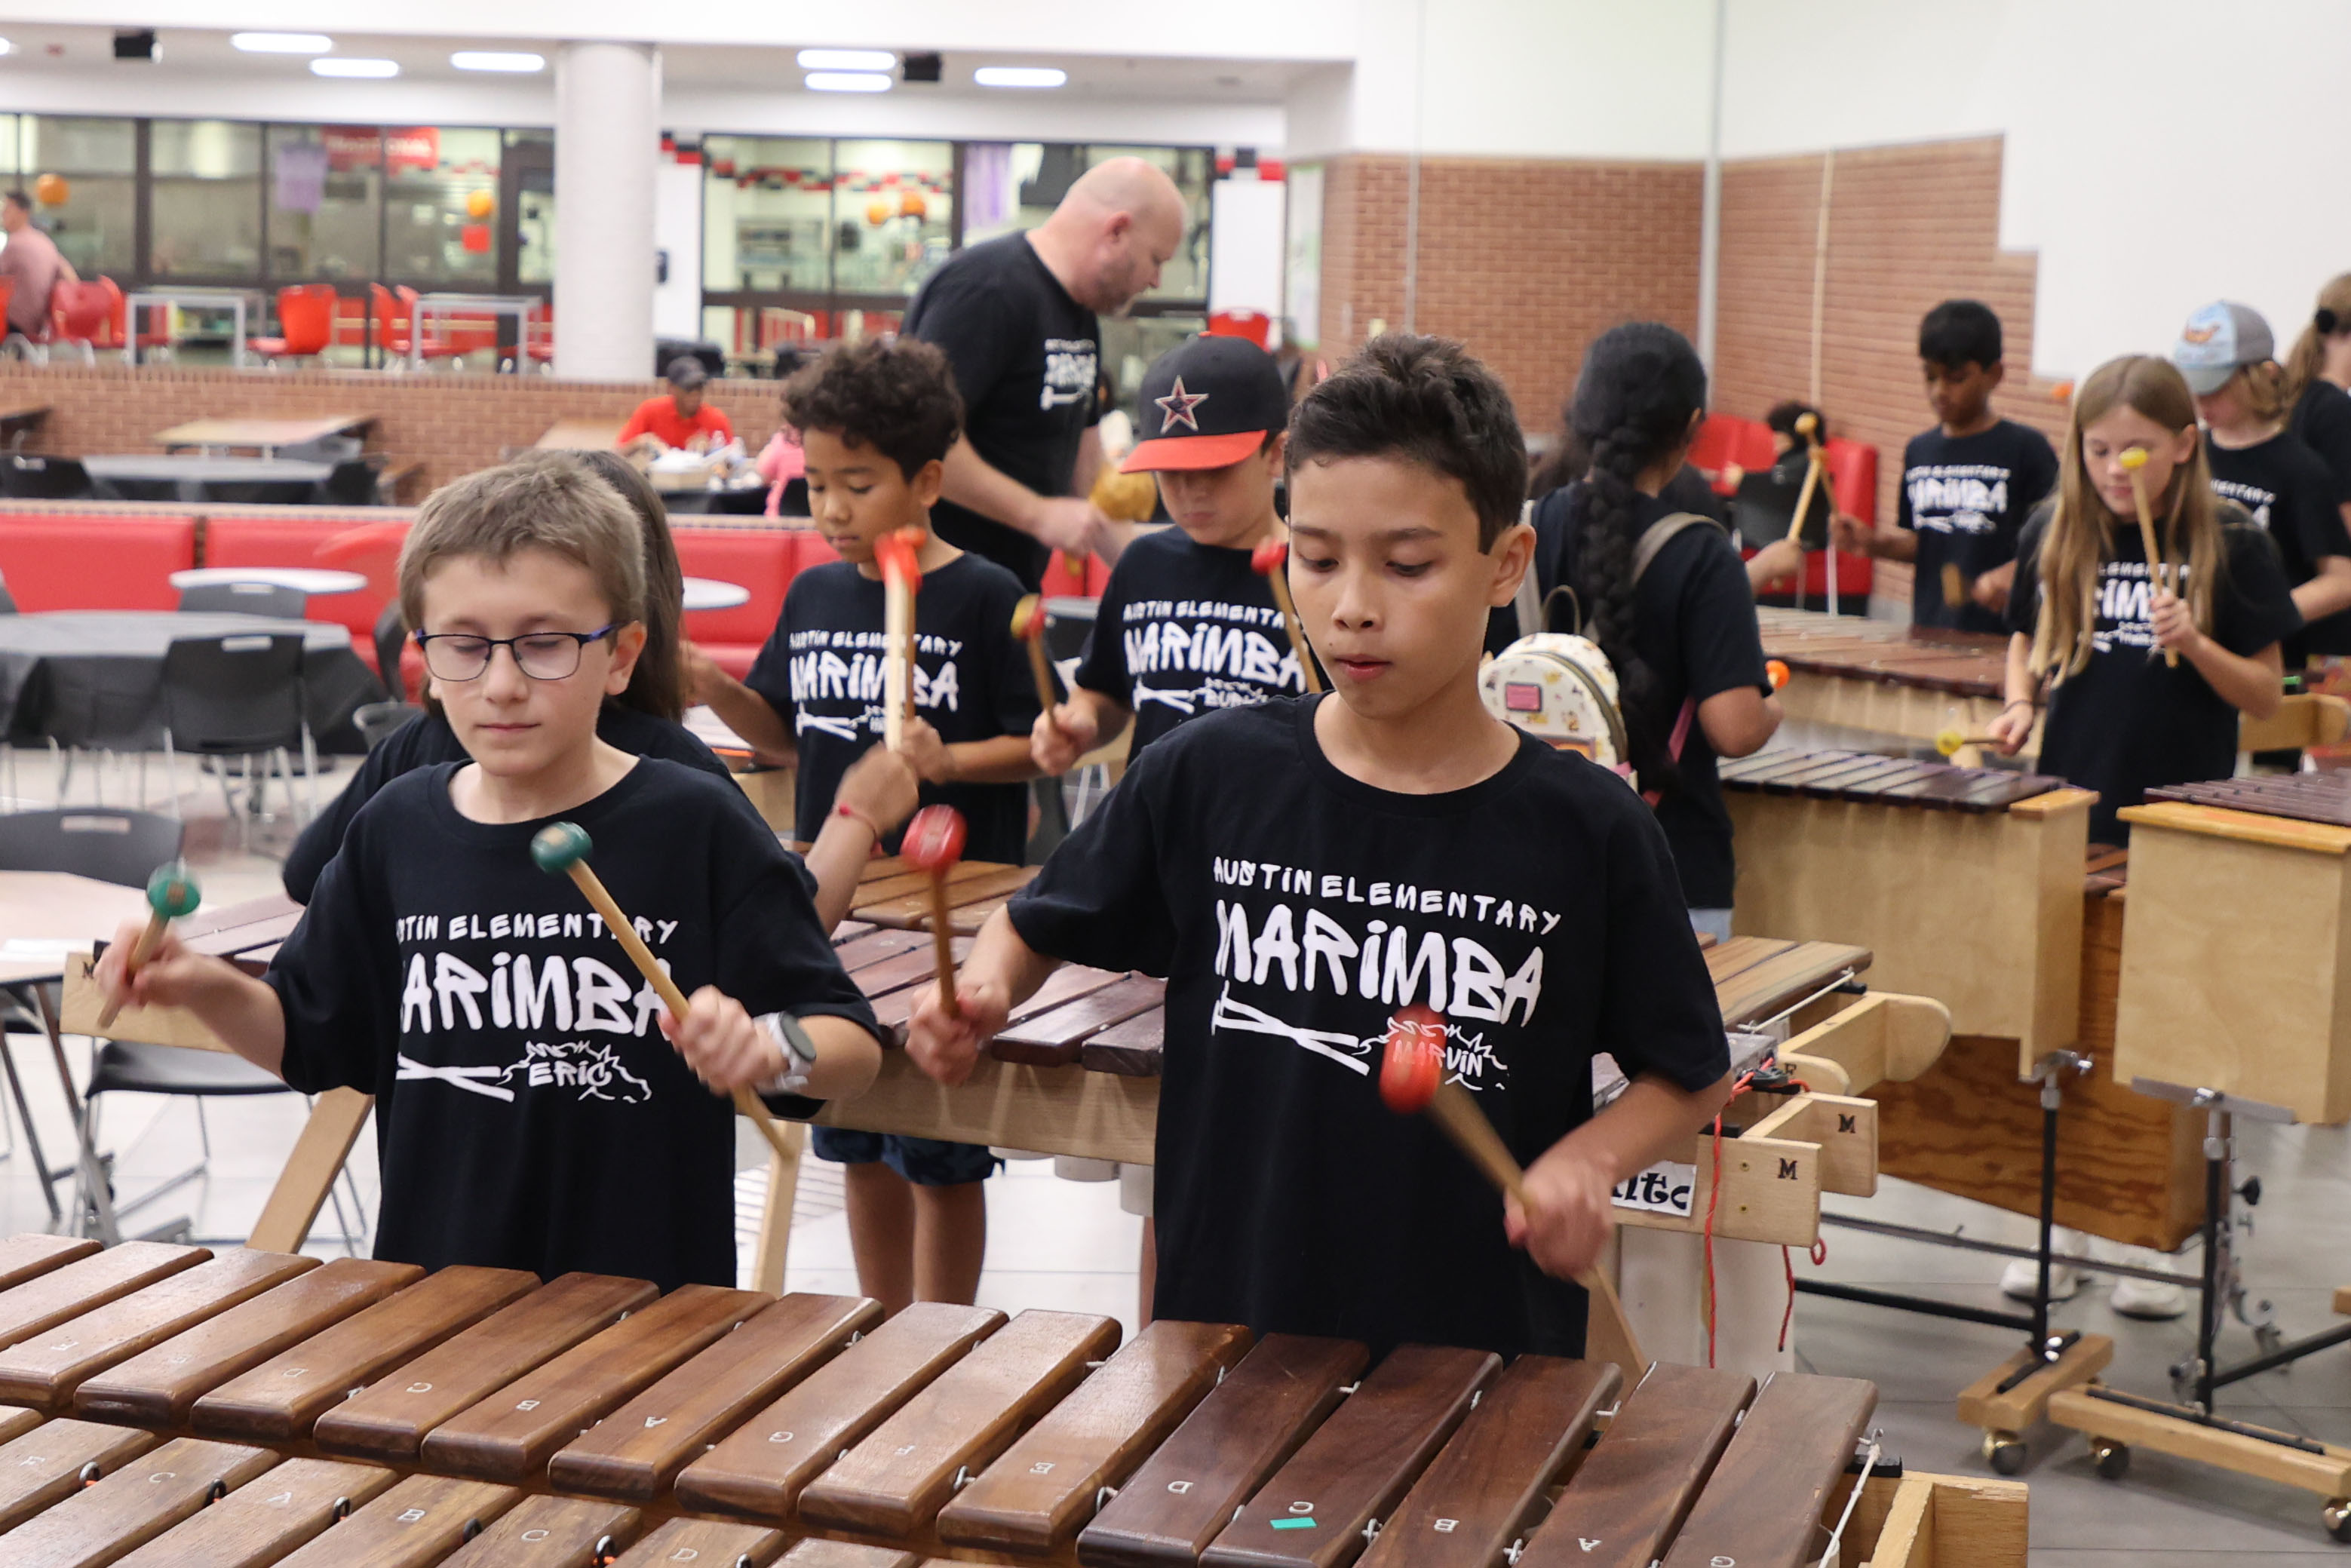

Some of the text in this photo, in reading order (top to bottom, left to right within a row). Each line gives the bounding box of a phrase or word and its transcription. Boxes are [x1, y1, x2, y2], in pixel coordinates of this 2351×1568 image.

[1320, 874, 1561, 936] ELEMENTARY
[449, 912, 679, 944] ELEMENTRY
[1838, 1112, 1856, 1134] M
[1777, 1157, 1798, 1180] M
[516, 1399, 541, 1412] B
[644, 1416, 668, 1428] A
[768, 1431, 794, 1444] G
[1029, 1461, 1056, 1474] E
[148, 1471, 177, 1484] C
[1168, 1481, 1194, 1495] D
[265, 1490, 293, 1506] A
[1288, 1501, 1315, 1514] C
[396, 1508, 426, 1524] B
[1433, 1518, 1460, 1534] B
[520, 1529, 551, 1542] C
[1577, 1537, 1604, 1553] A
[668, 1547, 699, 1562] D
